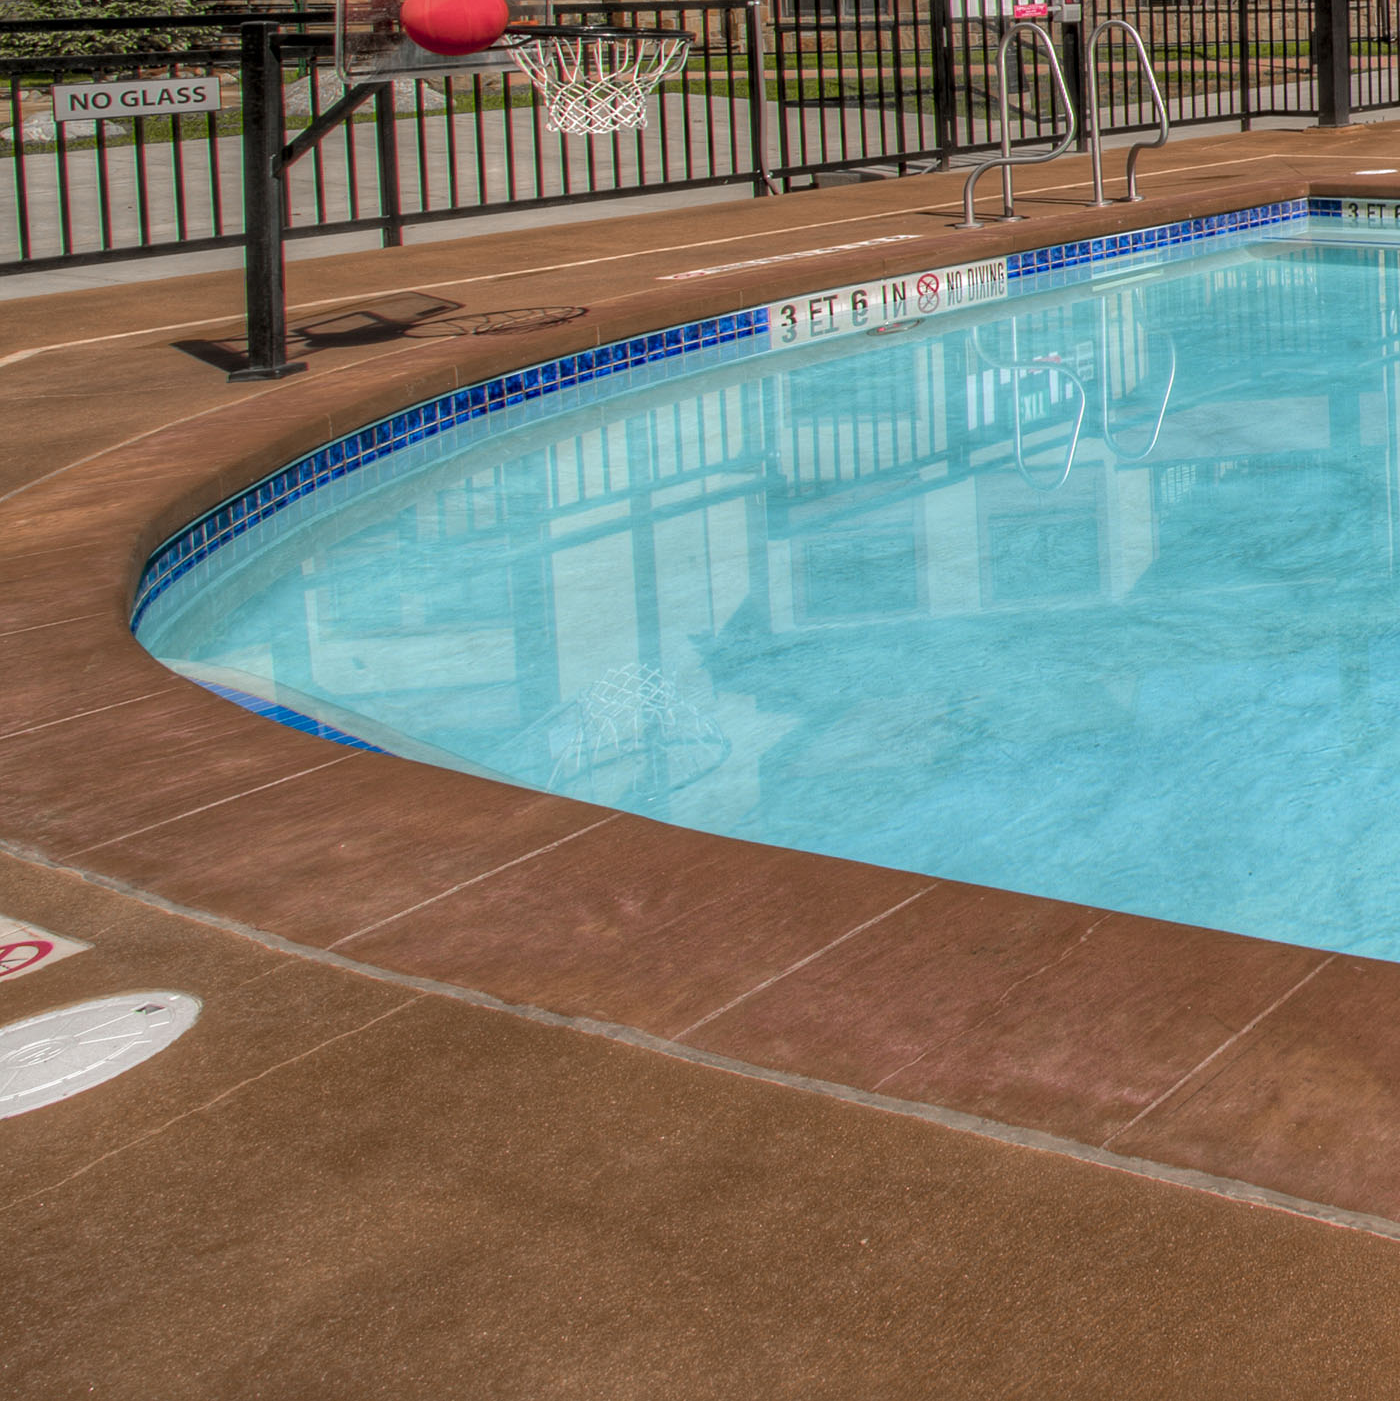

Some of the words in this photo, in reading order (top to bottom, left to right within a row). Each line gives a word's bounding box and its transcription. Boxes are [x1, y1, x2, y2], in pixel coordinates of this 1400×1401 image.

[69, 92, 113, 112] NO
[120, 85, 207, 108] GLASS
[780, 304, 797, 327] 3
[809, 295, 838, 321] FT
[851, 288, 868, 311] 6
[881, 280, 906, 304] IN
[946, 271, 962, 291] NO
